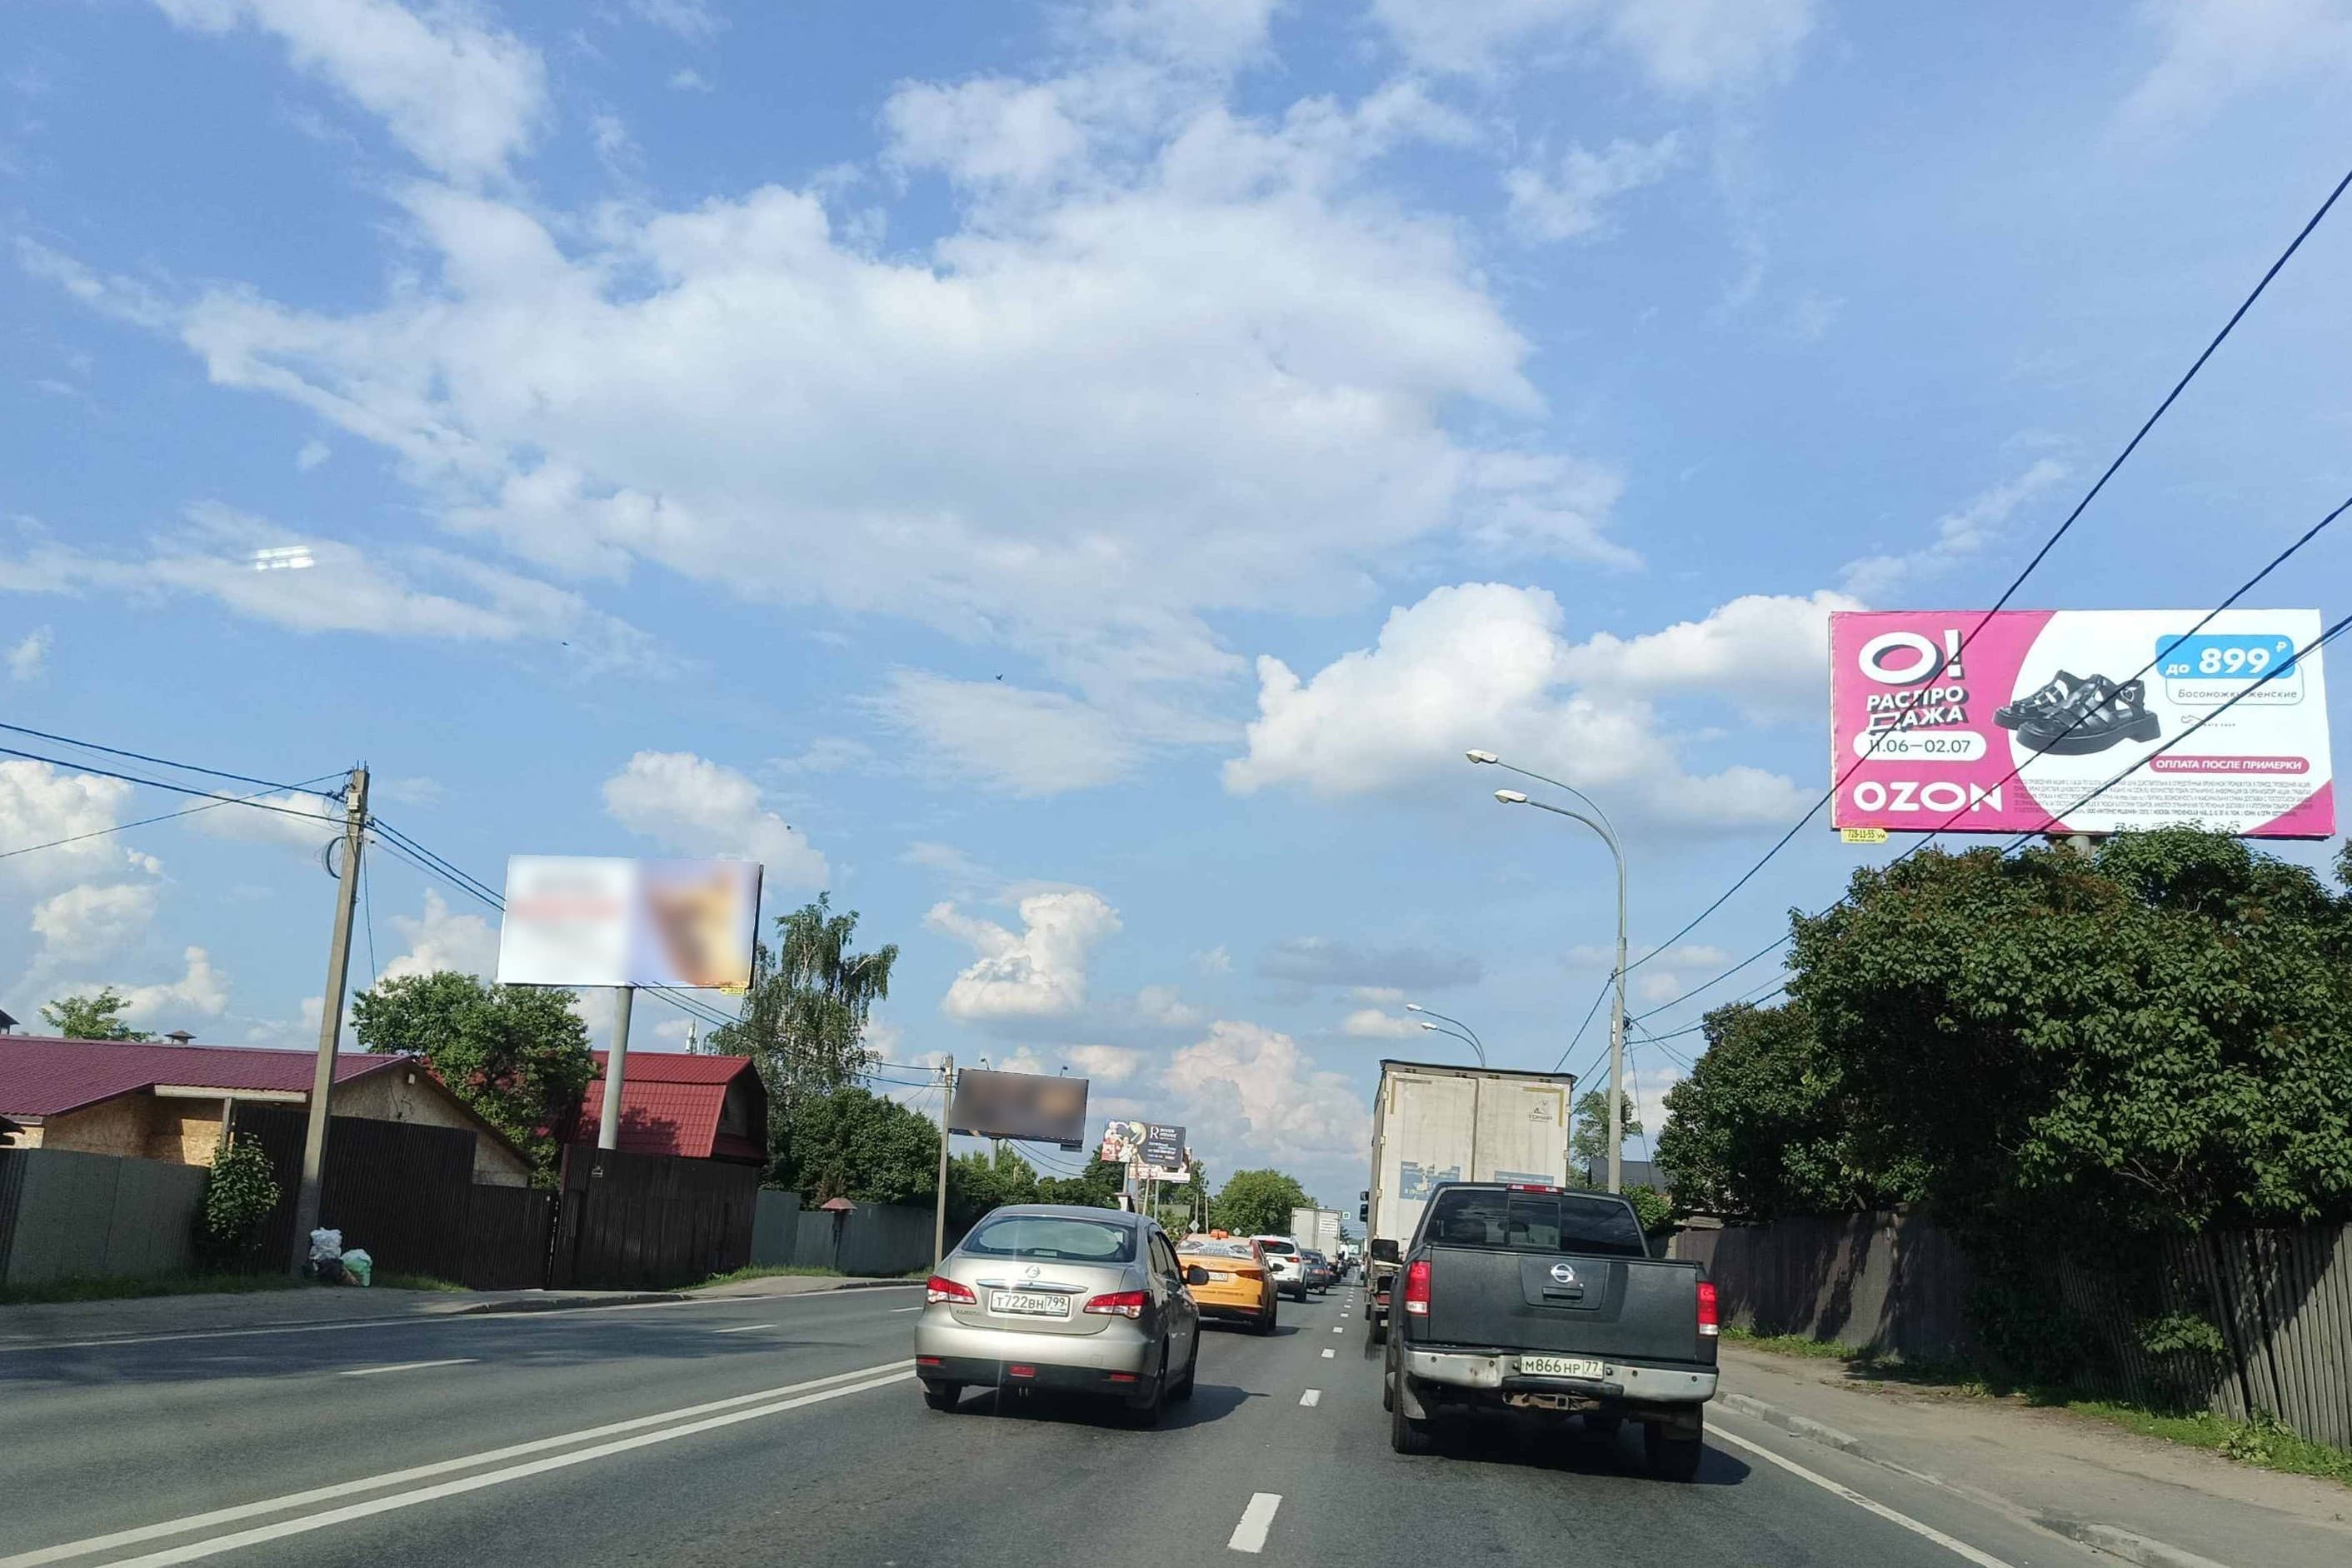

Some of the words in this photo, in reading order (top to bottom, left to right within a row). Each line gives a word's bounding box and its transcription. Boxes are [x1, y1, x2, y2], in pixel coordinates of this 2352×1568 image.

[1859, 629, 1963, 685] О!
[2166, 663, 2190, 676] до
[2199, 647, 2270, 674] 899
[1866, 686, 1965, 712] РАСПРО
[1866, 705, 1964, 733] ДАЖА
[2155, 759, 2200, 769] ОПЛАТА
[2202, 760, 2240, 769] ПОСЛЕ
[2242, 760, 2302, 770] ПРИМЕРКИ
[1853, 781, 2003, 812] OZON
